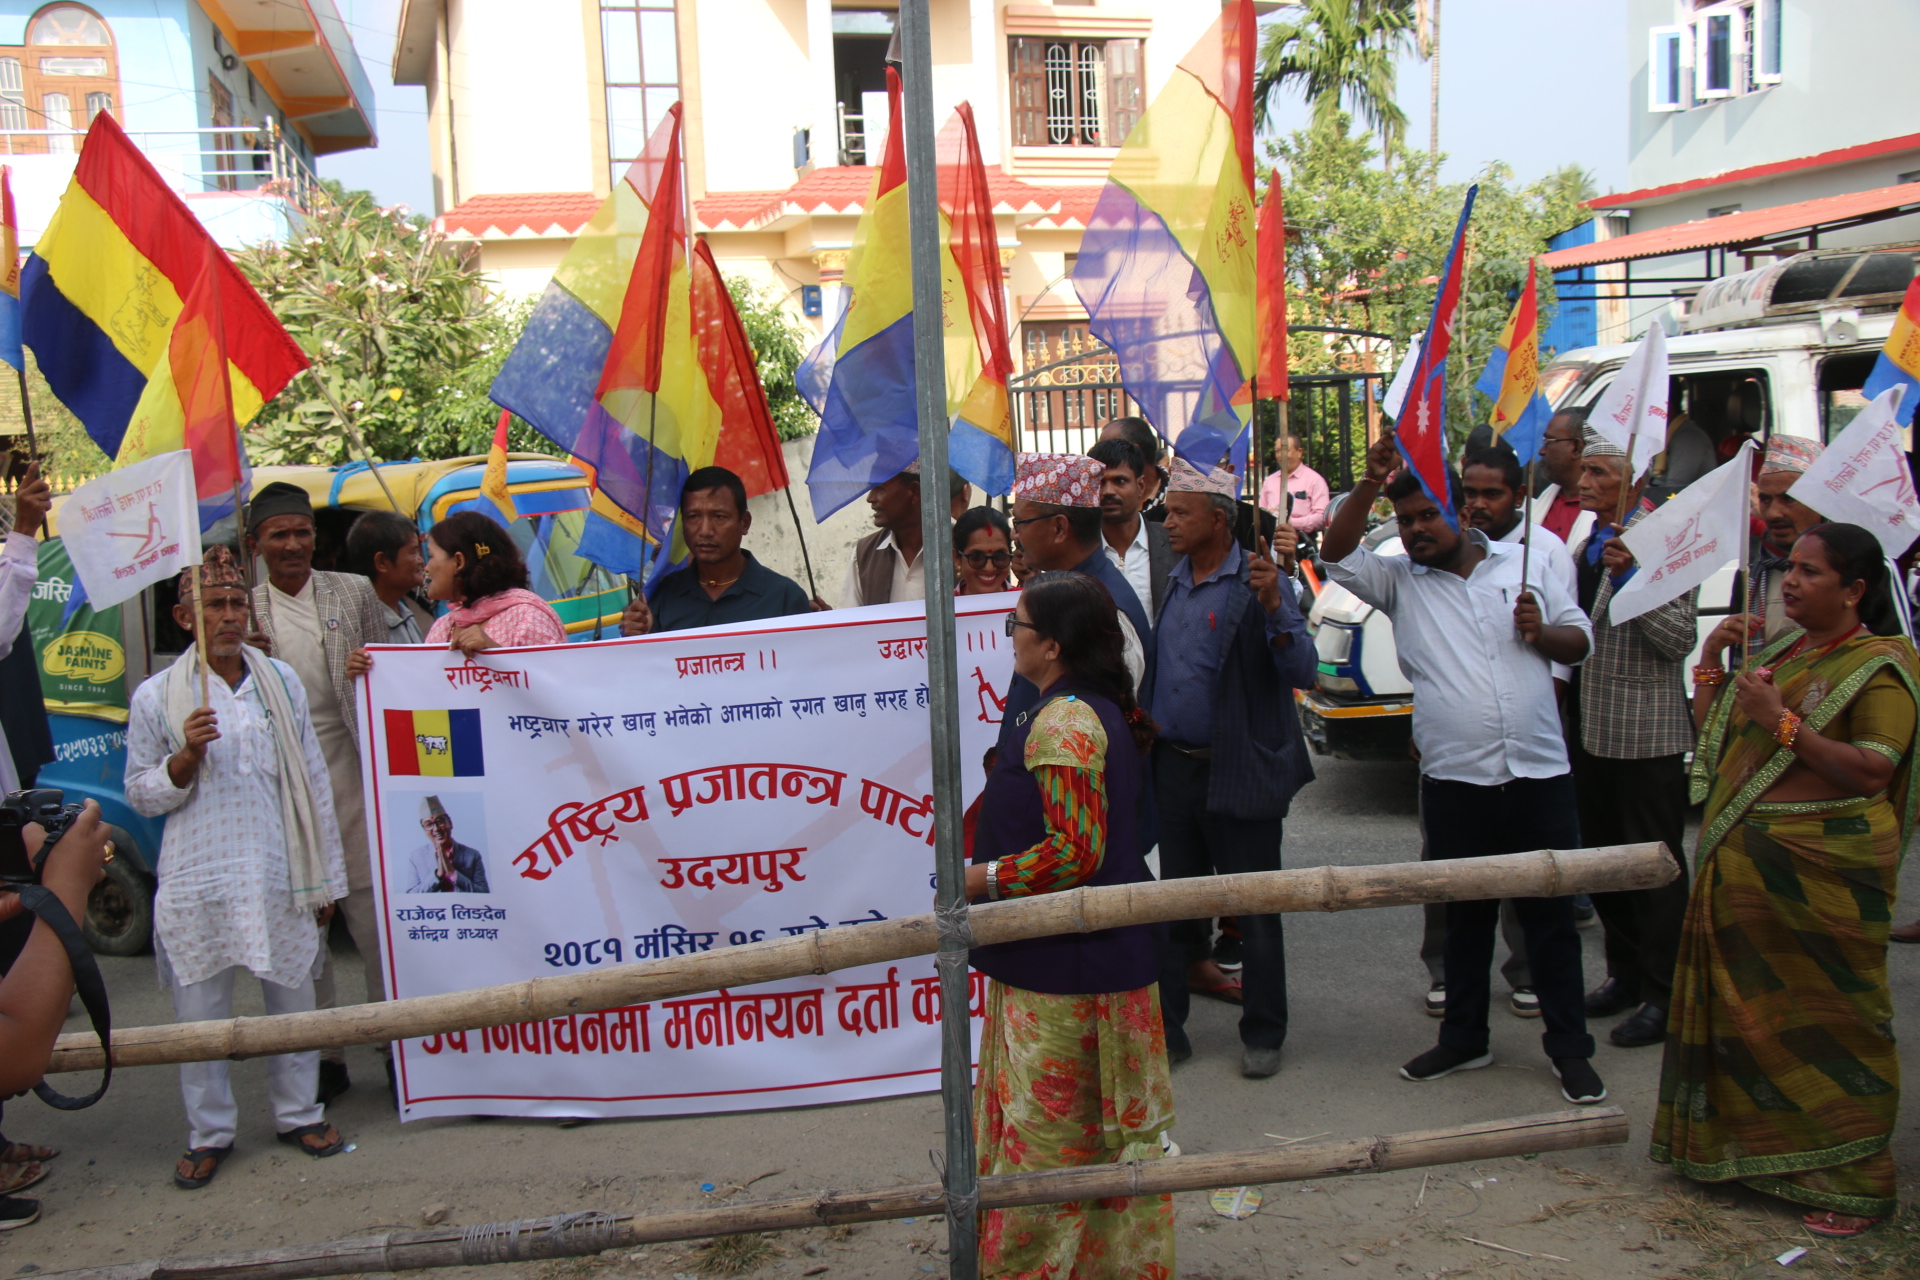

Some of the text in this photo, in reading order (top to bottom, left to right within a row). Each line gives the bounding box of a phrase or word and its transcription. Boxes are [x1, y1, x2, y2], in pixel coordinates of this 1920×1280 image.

[57, 643, 113, 660] JASMINE
[65, 656, 107, 670] PAINTS
[675, 652, 746, 679] प्रजातन्त्र
[60, 683, 84, 692] SINCE
[577, 712, 614, 738] गरेर
[621, 711, 656, 737] खानु
[664, 702, 713, 727] भनेको
[720, 696, 782, 723] आमाको
[789, 697, 825, 719] रगत
[833, 693, 867, 718] खानु
[874, 689, 908, 711] सरह
[512, 785, 649, 881] राष्ट्रिय
[659, 763, 847, 818] प्रजातन्त्र
[658, 847, 808, 893] उदयपुर
[396, 905, 447, 921] राजेन्द्र
[407, 925, 499, 942] केन्द्रिय अध्यक्ष
[544, 938, 622, 967] २०८१
[634, 924, 719, 959] मंसिर
[836, 967, 900, 1037] दर्ता
